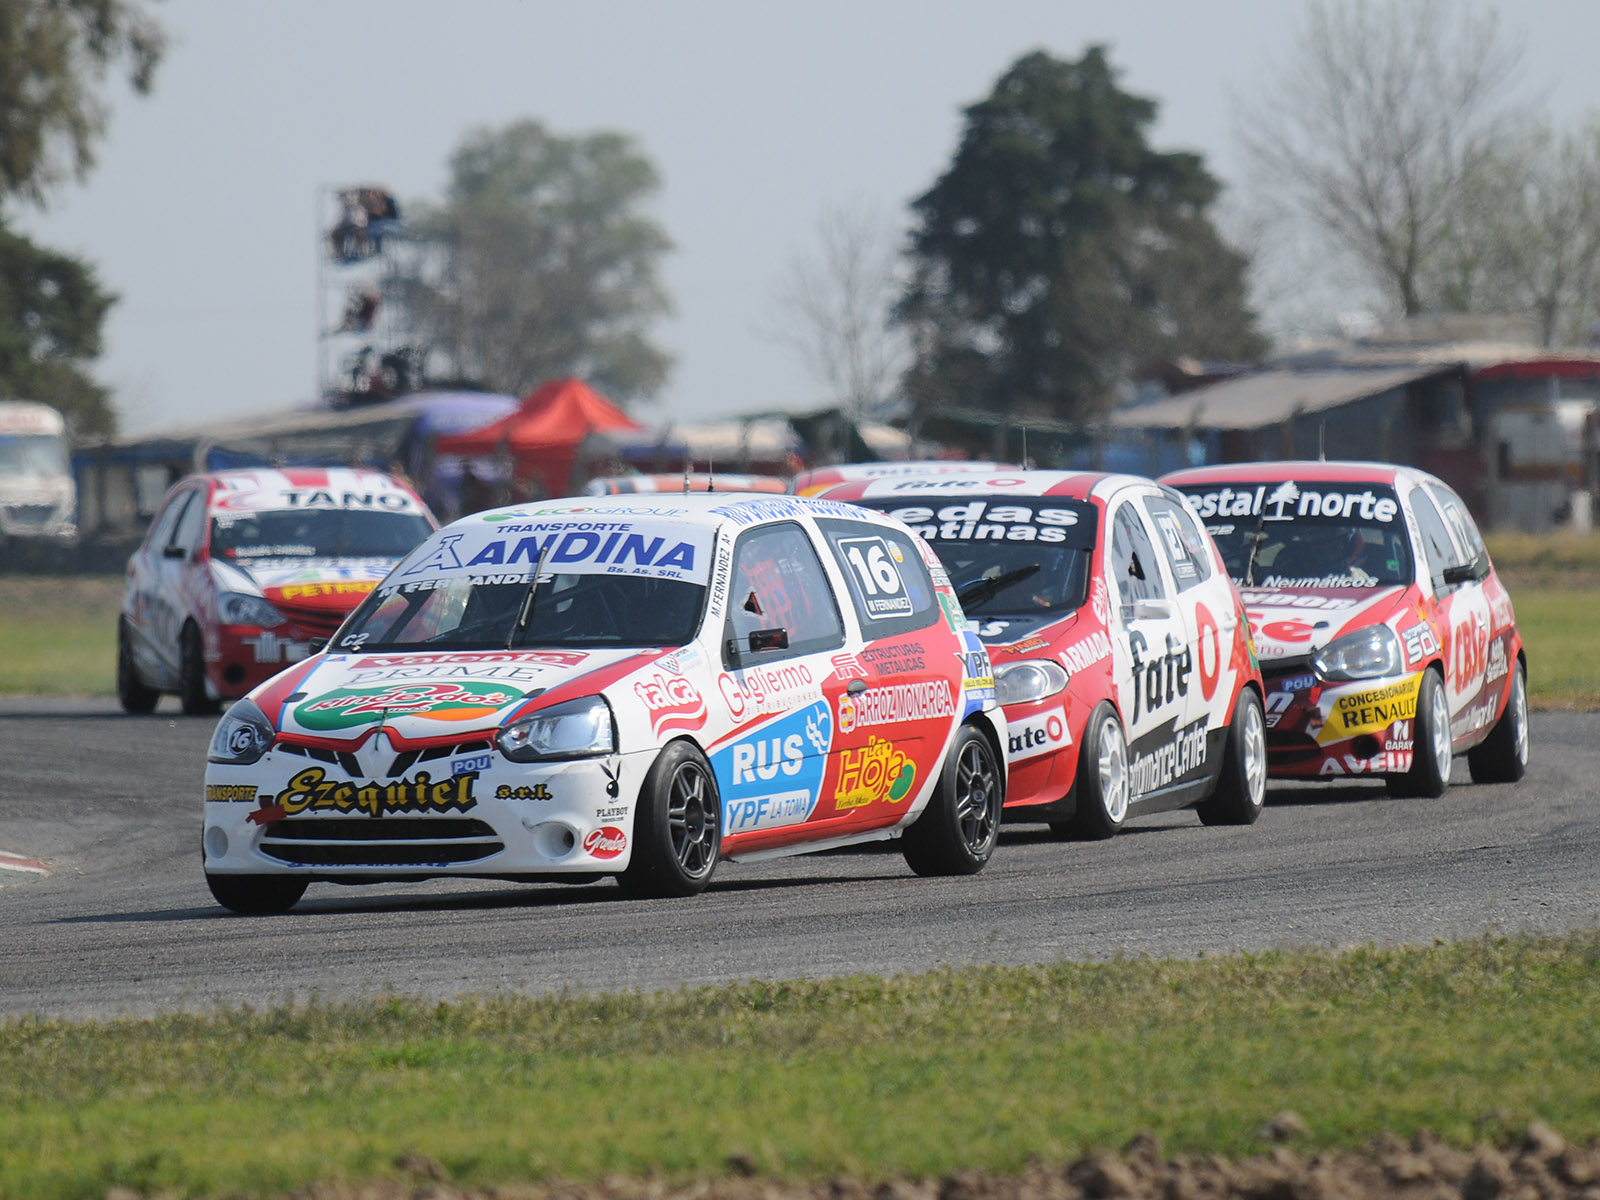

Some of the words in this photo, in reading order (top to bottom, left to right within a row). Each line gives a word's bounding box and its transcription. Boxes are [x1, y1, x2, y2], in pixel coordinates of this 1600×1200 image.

[281, 490, 411, 508] TANO
[1190, 486, 1266, 517] estal
[1299, 491, 1398, 522] norte
[888, 501, 1079, 526] edas
[497, 523, 633, 533] TRANSPORTE
[911, 520, 1068, 543] ntinas
[466, 532, 696, 571] ANDINA
[607, 566, 629, 574] Bs.
[658, 570, 682, 578] SRL
[848, 545, 900, 595] 16
[341, 633, 369, 646] C2
[860, 642, 925, 662] ESTRUCTURAS
[1406, 630, 1441, 666] SOL
[875, 657, 926, 676] METALICAS
[956, 651, 988, 678] YPF
[1059, 630, 1114, 677] ARMADA
[350, 667, 543, 684] PRIME
[1131, 630, 1192, 726] fate
[635, 674, 700, 710] talca
[718, 664, 812, 723] Gugliermo
[856, 685, 896, 727] ARROZ
[896, 680, 956, 723] MONARCA
[1339, 681, 1415, 709] CONCESIONARIOS
[1342, 697, 1415, 729] RENAULT
[231, 731, 251, 749] 16
[1008, 726, 1047, 754] ate
[1385, 740, 1415, 751] GARAY
[454, 757, 488, 772] POU
[732, 735, 804, 786] RUS
[206, 785, 259, 802] TRANSPORTE
[276, 767, 480, 818] Ezequiel
[596, 807, 629, 817] PLAYBOY
[728, 798, 770, 829] YPF
